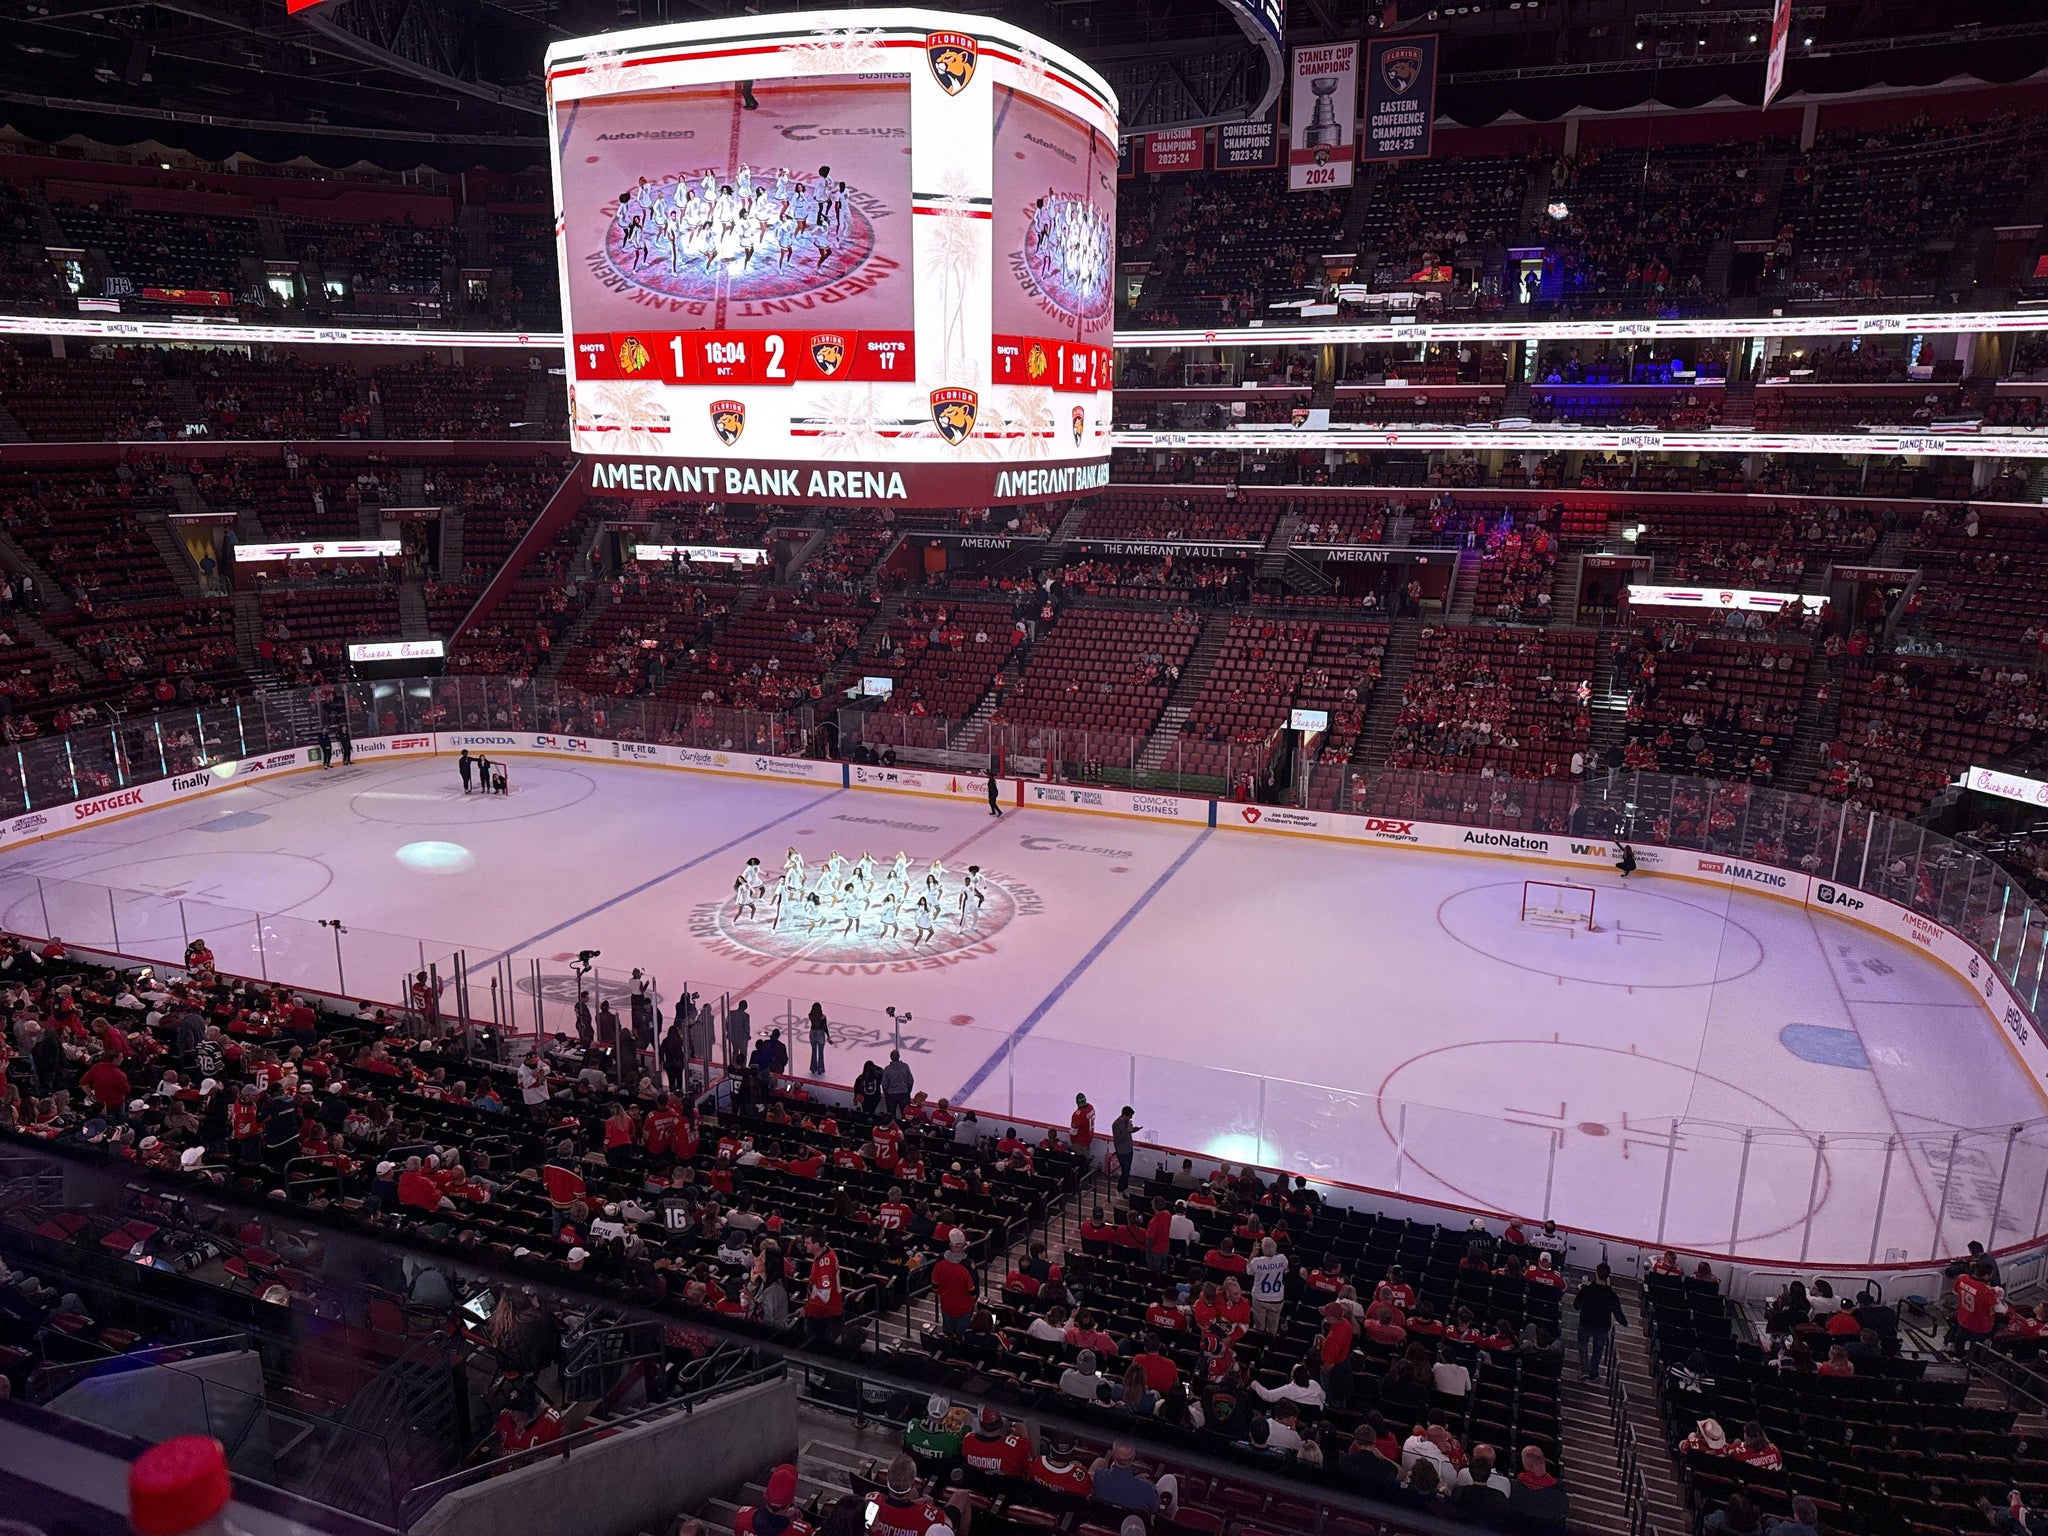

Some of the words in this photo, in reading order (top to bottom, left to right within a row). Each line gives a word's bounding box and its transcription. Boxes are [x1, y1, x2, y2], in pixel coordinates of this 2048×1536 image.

[930, 34, 974, 49] FLORIDA
[1297, 49, 1334, 63] STANLEY
[1335, 46, 1354, 60] CUP
[1385, 48, 1420, 62] FLORIDA
[1299, 59, 1351, 75] CHAMPIONS
[1379, 99, 1419, 114] EASTERN
[1371, 112, 1425, 127] CONFERENCE
[596, 129, 695, 142] AutoNation
[817, 126, 906, 137] CELSIUS
[1156, 128, 1192, 141] DIVISION
[1222, 123, 1273, 138] CONFERENCE
[1372, 124, 1423, 139] CHAMPIONS
[1023, 132, 1077, 164] AutoNation
[1151, 139, 1197, 153] CHAMPIONS
[1223, 135, 1270, 150] CHAMPIONS
[1378, 138, 1415, 152] 2024-25
[1157, 152, 1191, 165] 2023-24
[1229, 148, 1263, 161] 2023-24
[1305, 168, 1335, 185] 2024
[584, 250, 637, 294] ARENA
[1008, 250, 1042, 298] ARENA
[628, 288, 708, 317] BANK
[1036, 296, 1078, 329] BANK
[107, 323, 123, 333] DANCE
[124, 323, 138, 333] TEAM
[1618, 325, 1634, 334] DANCE
[1635, 324, 1651, 333] TEAM
[1863, 319, 1883, 330] DANCE
[1883, 318, 1901, 329] TEAM
[319, 331, 333, 340] DANCE
[333, 332, 347, 340] TEAM
[1397, 328, 1412, 337] DANCE
[1412, 328, 1427, 337] TEAM
[812, 335, 842, 345] FLORIDA
[867, 341, 906, 351] SHOTS
[579, 343, 605, 352] SHOTS
[704, 341, 746, 364] 16:04
[996, 345, 1019, 355] SHOTS
[589, 355, 597, 370] 3
[669, 335, 684, 378] 1
[764, 334, 786, 379] 2
[879, 352, 895, 370] 17
[716, 367, 733, 376] INT.
[1005, 356, 1011, 373] 3
[1057, 345, 1065, 385] 1
[1090, 349, 1097, 387] 2
[935, 390, 974, 403] FLORIDA
[712, 402, 742, 413] FLORIDA
[1155, 435, 1171, 444] DANCE
[1171, 434, 1186, 444] TEAM
[1621, 436, 1643, 447] DANCE
[1643, 436, 1661, 446] TEAM
[1898, 439, 1924, 451] DANCE
[1924, 439, 1945, 451] TEAM
[591, 462, 720, 493] AMERANT
[724, 467, 801, 497] BANK
[806, 470, 908, 499] ARENA
[996, 467, 1076, 498] AMERANT
[1076, 464, 1098, 491] BANK
[382, 511, 396, 520] 129
[425, 510, 439, 519] 130
[960, 538, 1012, 550] AMERANT
[1103, 543, 1123, 555] THE
[1125, 544, 1181, 557] AMERANT
[1184, 546, 1225, 559] VAULT
[690, 549, 706, 558] DANCE
[706, 549, 719, 558] TEAM
[1327, 550, 1391, 563] AMERANT
[1586, 558, 1601, 568] 103
[1630, 559, 1646, 569] 104
[1842, 570, 1858, 580] 104
[1890, 571, 1907, 582] 105
[356, 741, 386, 753] Health
[391, 737, 430, 750] ESPN
[463, 736, 516, 745] HONDA
[536, 735, 556, 747] CH
[568, 739, 587, 749] CH
[622, 743, 636, 753] LIVE.
[637, 745, 647, 753] FIT.
[647, 746, 658, 754] GO.
[266, 753, 295, 764] ACTION
[768, 759, 794, 769] Broward
[794, 762, 814, 771] Health
[171, 771, 211, 792] finally
[1045, 787, 1066, 796] TROPICAL
[1045, 793, 1066, 801] FINANCIAL
[1081, 791, 1103, 800] TROPICAL
[74, 788, 144, 820] SEATGEEK
[1081, 797, 1104, 806] FINANCIAL
[1132, 795, 1179, 806] COMCAST
[1132, 803, 1179, 816] BUSINESS
[830, 813, 940, 833] AutoNation
[1263, 817, 1292, 825] Children's
[1293, 819, 1318, 828] Hospital
[1282, 813, 1310, 821] DiMaggio
[1365, 818, 1415, 835] DEX
[1375, 831, 1419, 842] imaging
[1463, 830, 1549, 852] AutoNation
[1056, 842, 1135, 858] CELSIUS
[1570, 843, 1607, 857] WM
[1633, 850, 1658, 858] DRIVING
[1701, 862, 1723, 872] MIKE'S
[1724, 864, 1786, 888] AMAZING
[687, 900, 724, 939] ARENA
[1902, 912, 1945, 940] AMERANT
[1911, 929, 1932, 947] BANK
[700, 936, 778, 967] BANK
[795, 940, 998, 977] AMERANT
[2003, 999, 2029, 1047] jetBlue
[864, 1031, 933, 1054] XL
[874, 1141, 890, 1160] 72
[664, 1207, 687, 1229] 16
[1468, 1239, 1491, 1249] KITH
[1261, 1272, 1282, 1294] 66
[967, 1454, 1002, 1471] DADONOV
